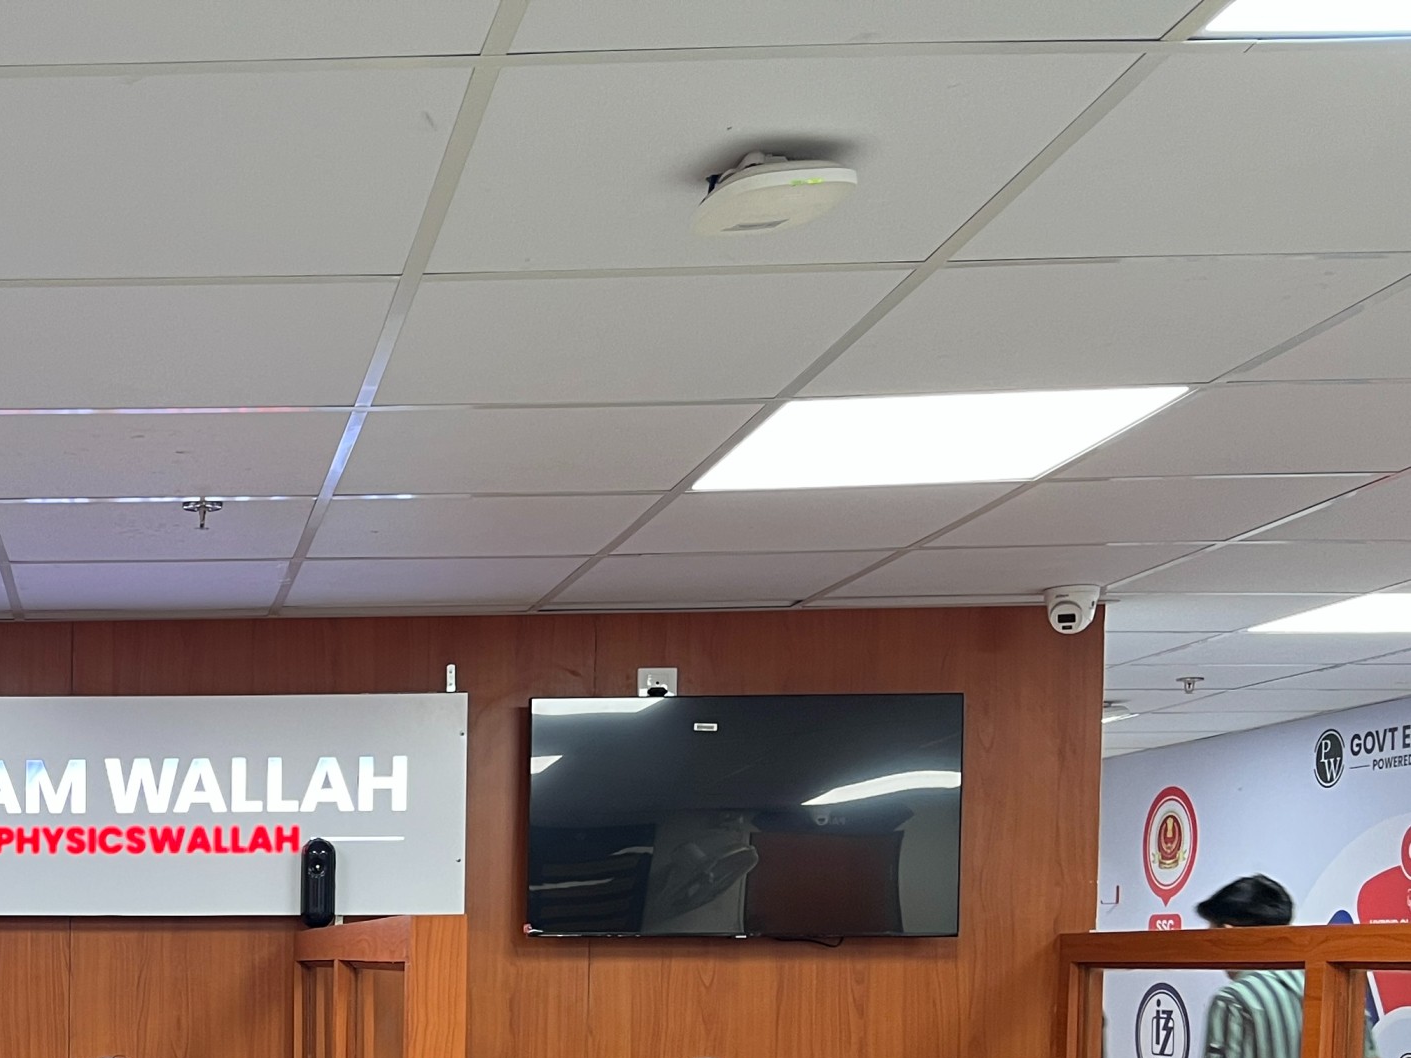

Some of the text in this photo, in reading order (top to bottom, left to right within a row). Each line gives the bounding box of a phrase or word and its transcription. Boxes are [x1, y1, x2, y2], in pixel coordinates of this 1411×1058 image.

[1350, 727, 1398, 756] GOVT
[104, 755, 408, 814] WALLAH
[1155, 919, 1175, 931] SSC
